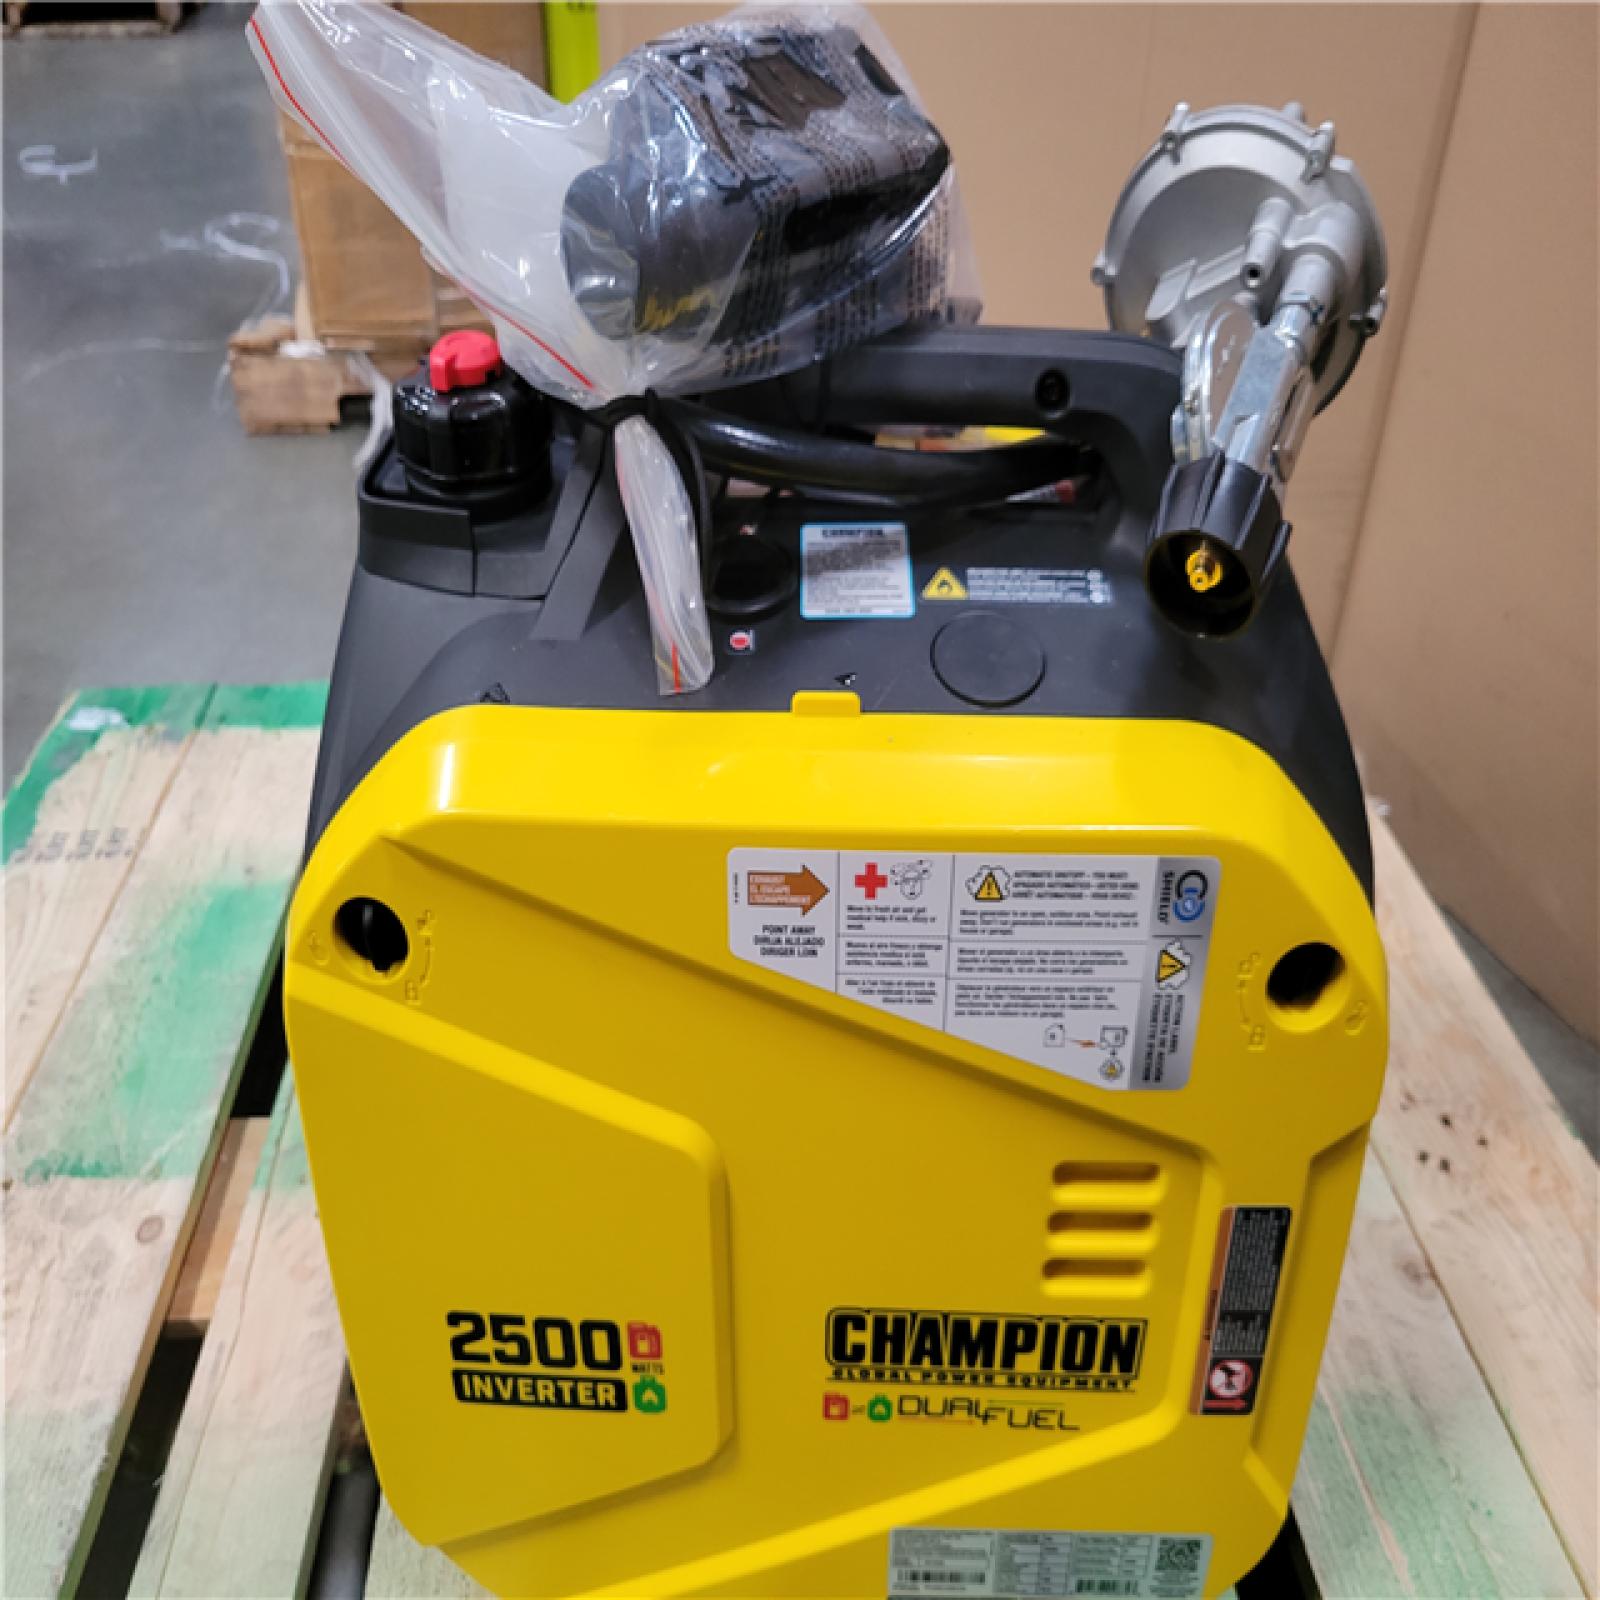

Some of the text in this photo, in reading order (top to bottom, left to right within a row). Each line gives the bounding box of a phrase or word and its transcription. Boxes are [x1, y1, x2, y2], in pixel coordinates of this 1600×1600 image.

[446, 1311, 623, 1370] 2500
[830, 1311, 1143, 1375] CHAMPION
[461, 1373, 617, 1407] INVERTER
[834, 1367, 1132, 1389] GLOBAL POWER EQUIPMENT
[979, 1407, 1081, 1431] FUEL
